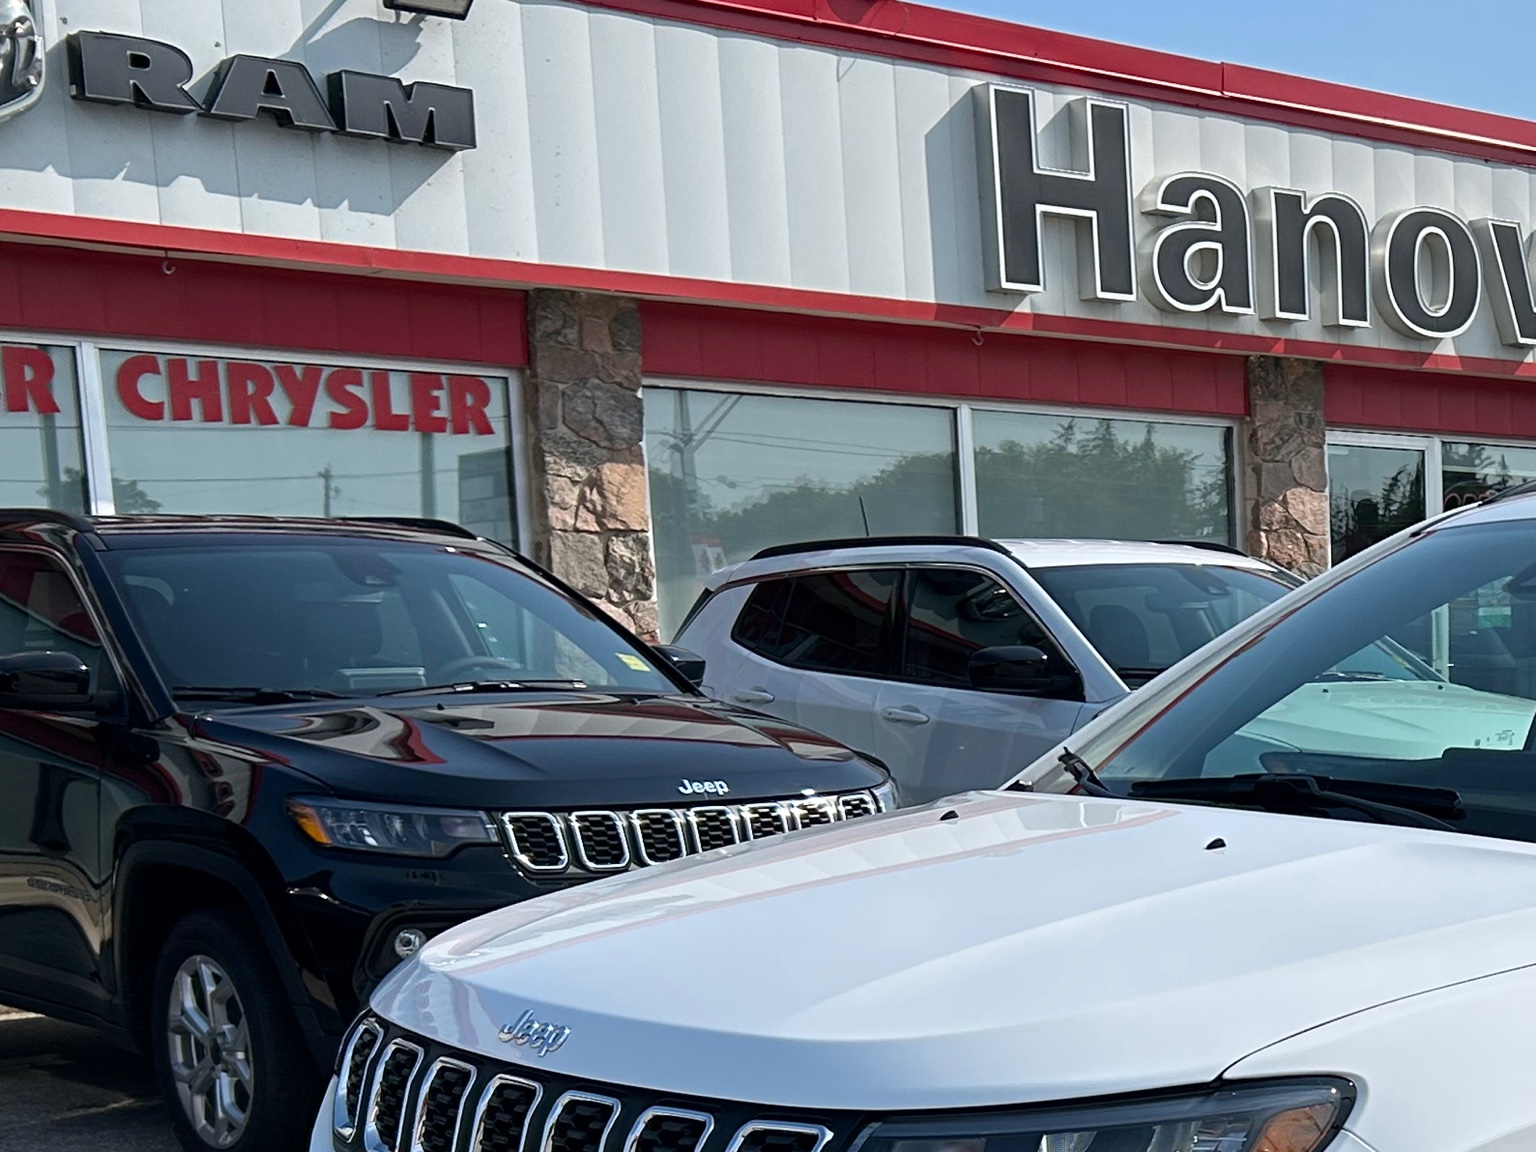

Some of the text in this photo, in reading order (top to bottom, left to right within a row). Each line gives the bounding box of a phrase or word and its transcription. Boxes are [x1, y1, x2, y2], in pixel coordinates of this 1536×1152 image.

[68, 30, 477, 151] RAM
[117, 355, 496, 436] CHRYSLER
[678, 779, 729, 795] Jeep
[498, 1009, 571, 1058] Jeep
